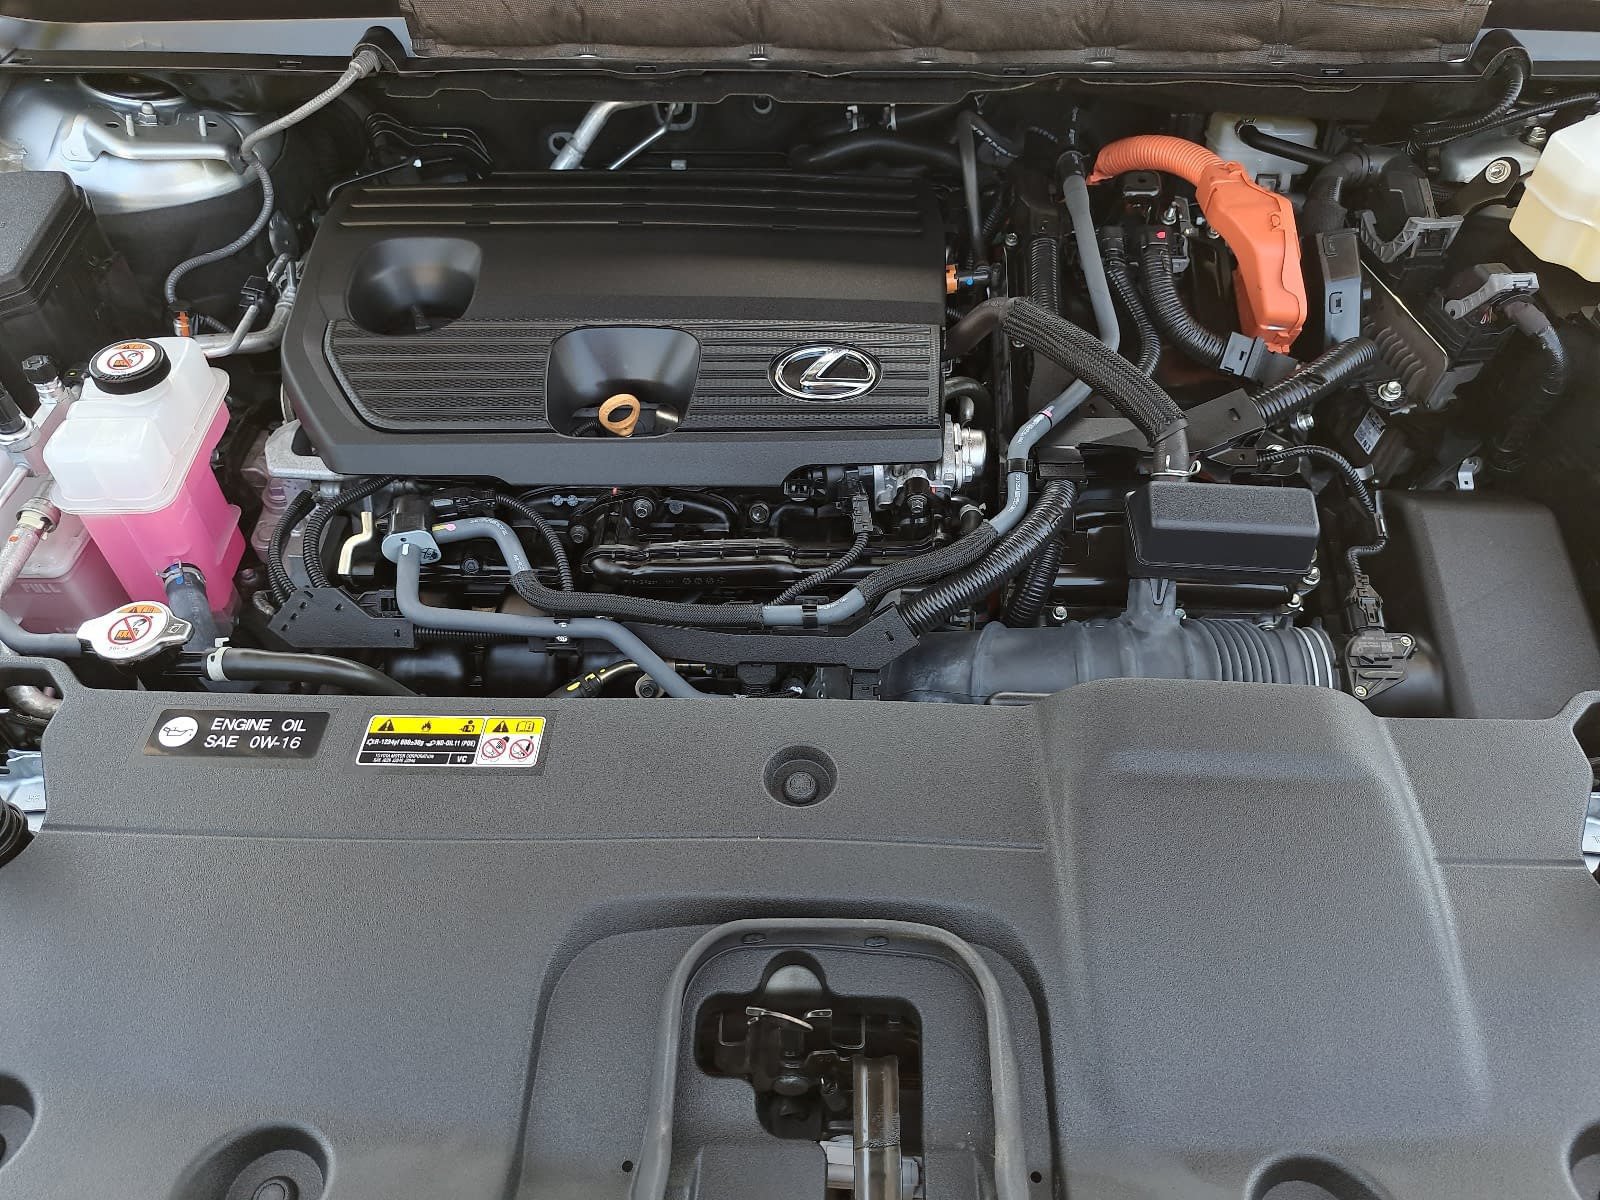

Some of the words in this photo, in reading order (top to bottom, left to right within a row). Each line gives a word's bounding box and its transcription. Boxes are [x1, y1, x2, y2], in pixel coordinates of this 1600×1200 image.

[21, 583, 61, 592] FULL
[211, 717, 272, 731] ENGINE
[281, 718, 307, 732] OIL
[204, 735, 239, 748] SAE
[249, 736, 301, 749] 0W-16
[457, 755, 468, 763] VC
